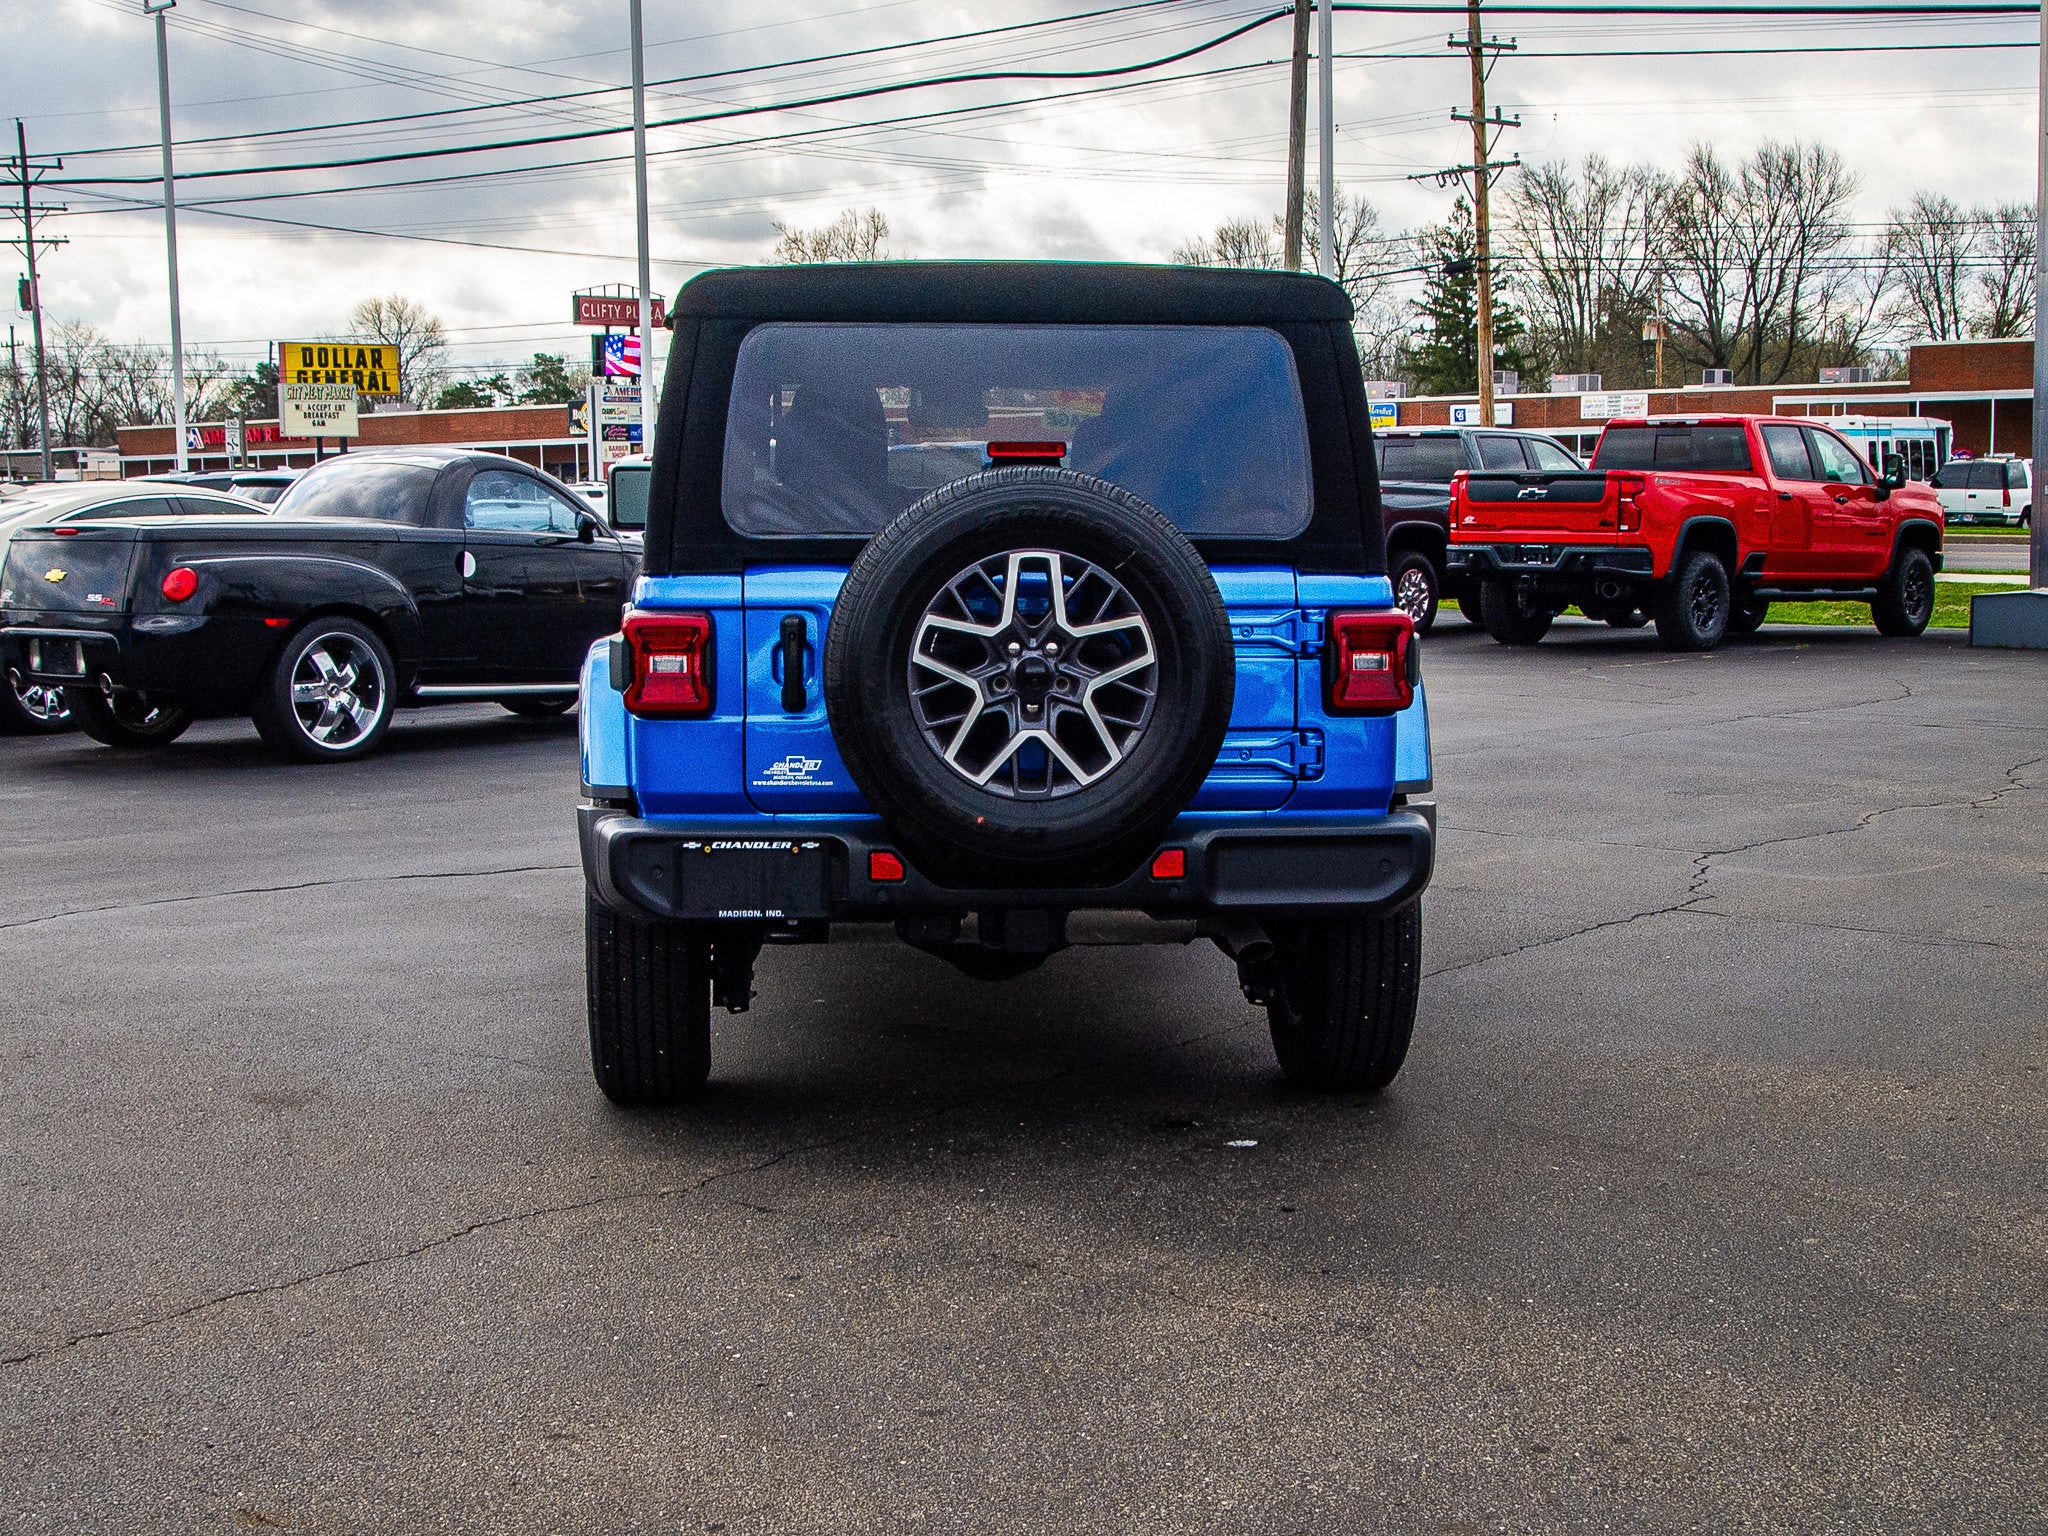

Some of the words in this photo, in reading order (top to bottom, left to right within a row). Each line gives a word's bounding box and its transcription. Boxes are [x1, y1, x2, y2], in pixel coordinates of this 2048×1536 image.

[581, 303, 621, 319] CLIFTY
[625, 305, 663, 320] PLA
[301, 346, 383, 369] DOLLAR
[296, 369, 391, 391] GENERAL
[286, 385, 304, 400] CITY
[303, 384, 325, 400] MEAT
[324, 385, 355, 400] MARKET
[303, 411, 340, 419] BREAKFAST
[203, 427, 261, 444] AMEAN
[772, 761, 816, 769] CHANDLER
[711, 841, 793, 849] CHANDLER
